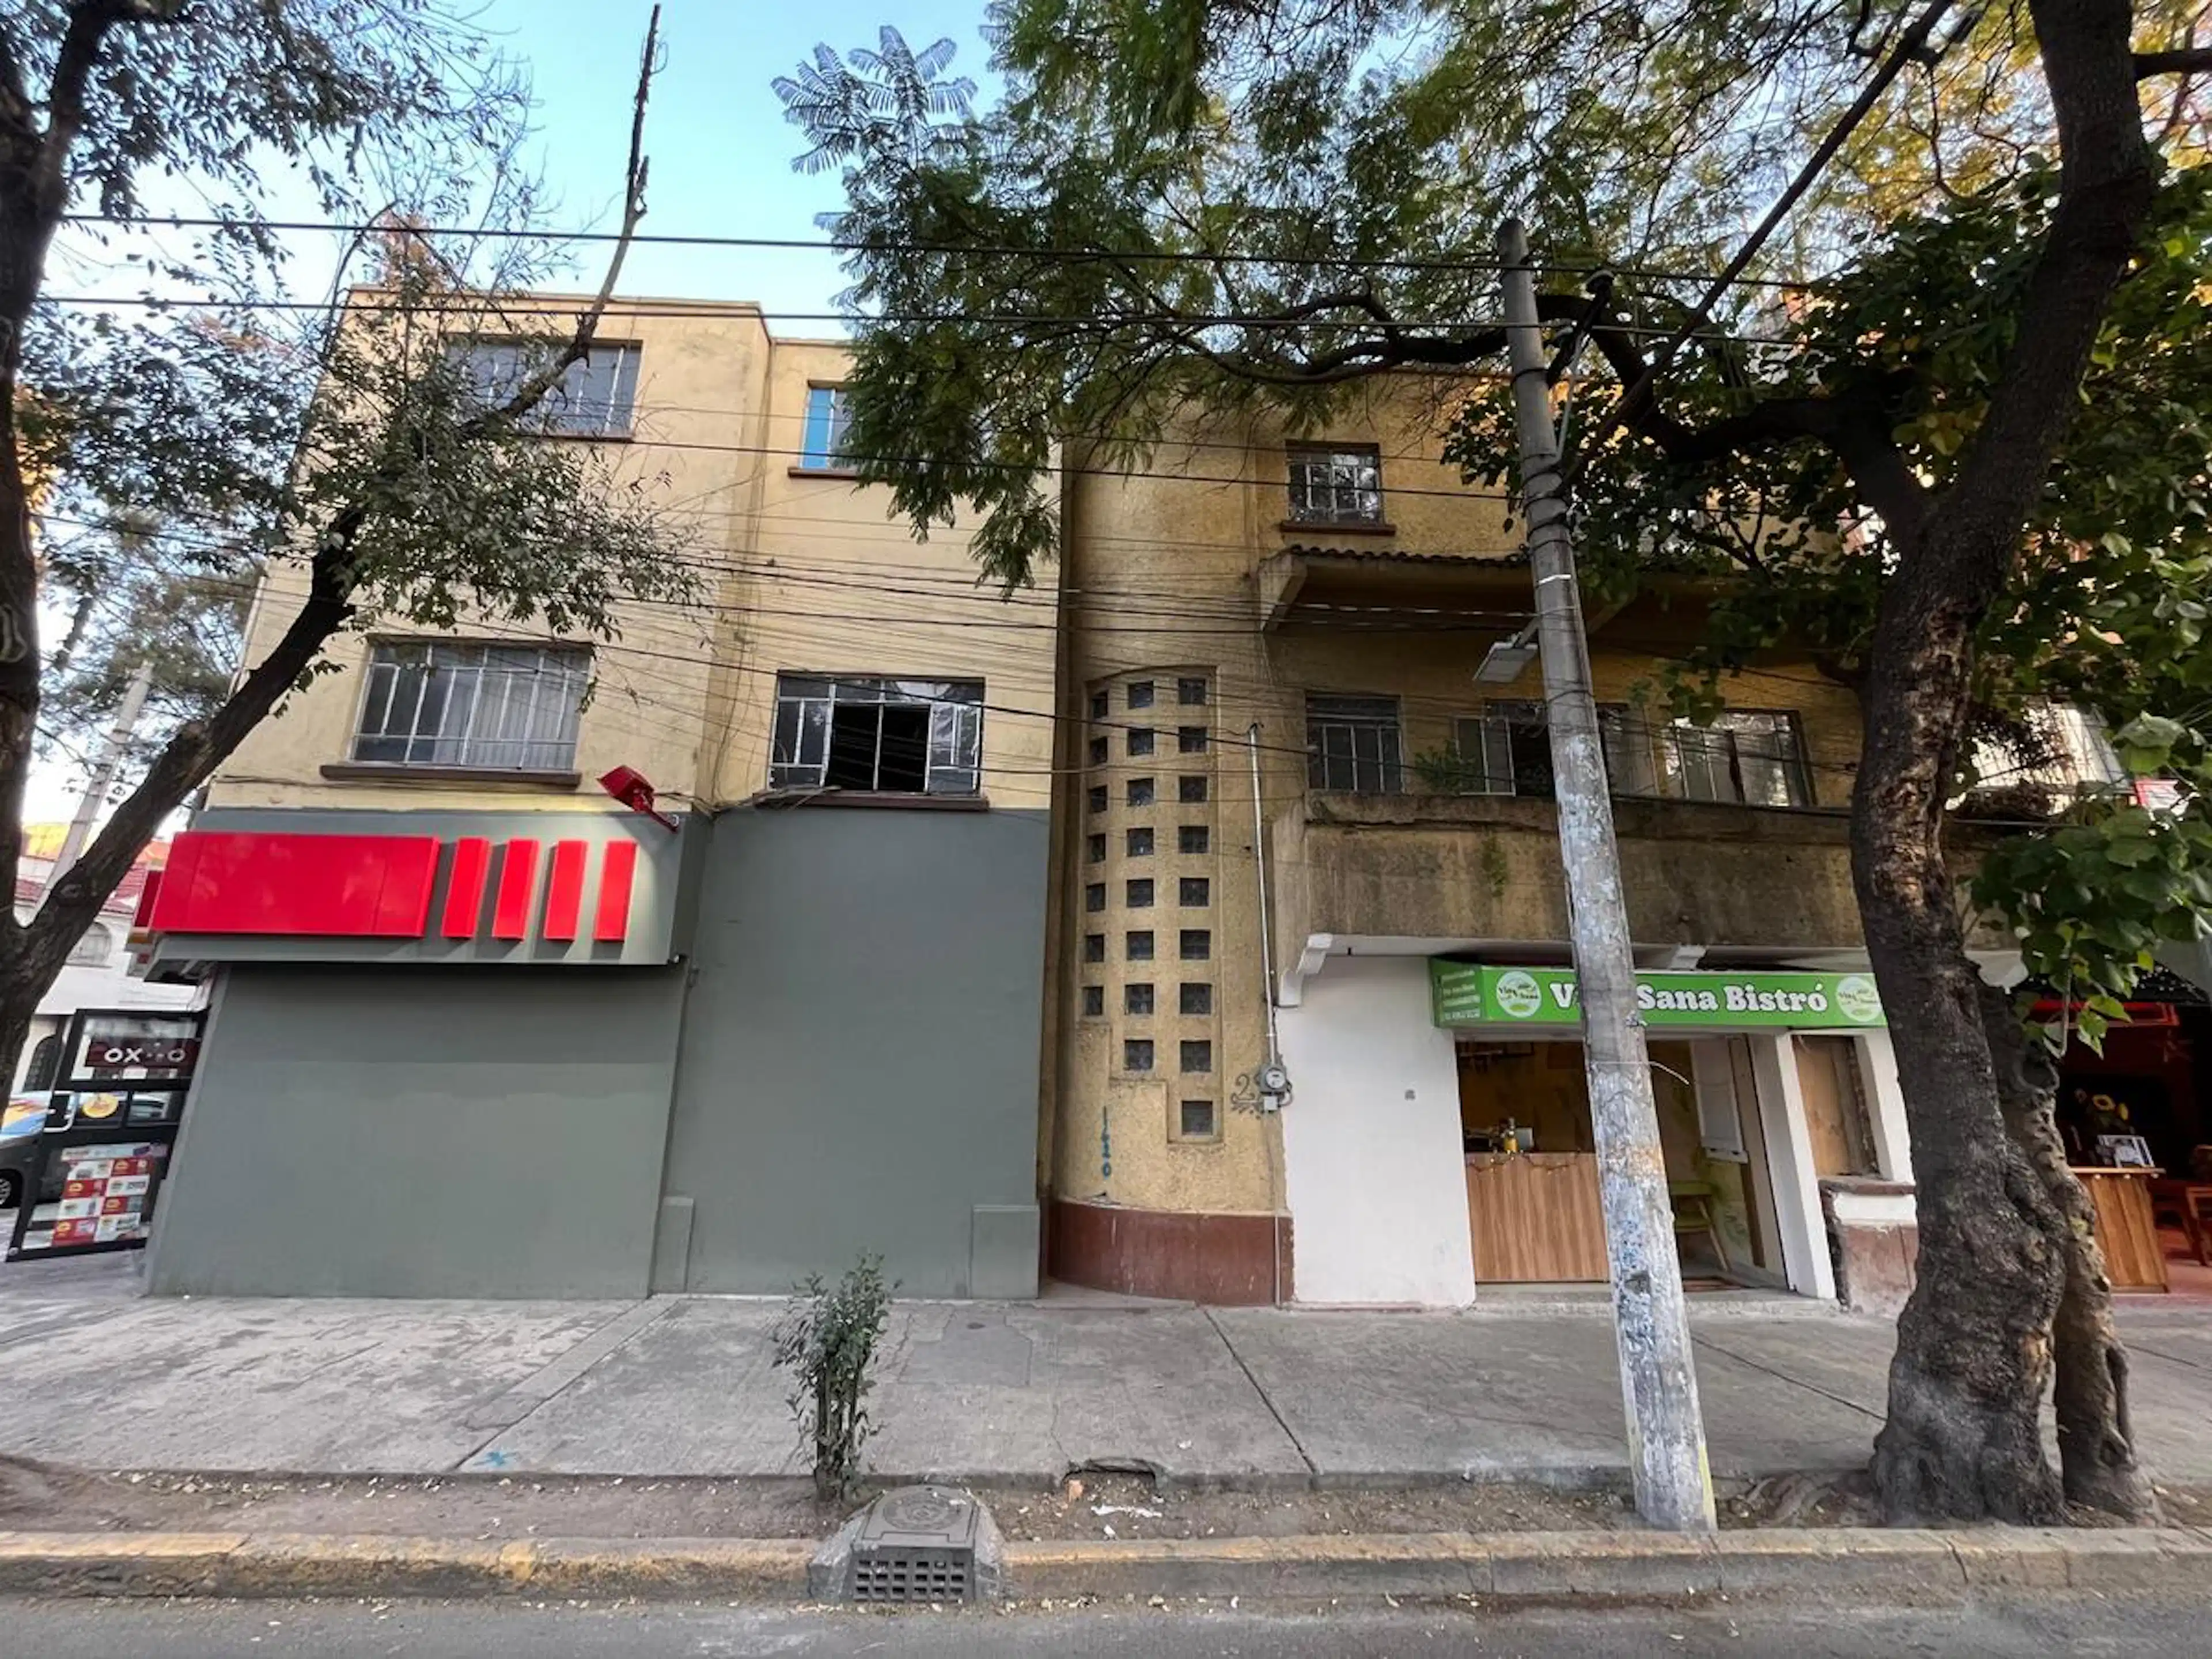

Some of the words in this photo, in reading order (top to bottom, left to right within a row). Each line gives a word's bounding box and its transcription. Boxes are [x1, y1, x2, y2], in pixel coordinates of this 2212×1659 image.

[1637, 983, 1719, 1010] Sana
[1724, 983, 1828, 1012] Bistró
[104, 1047, 185, 1063] OXO
